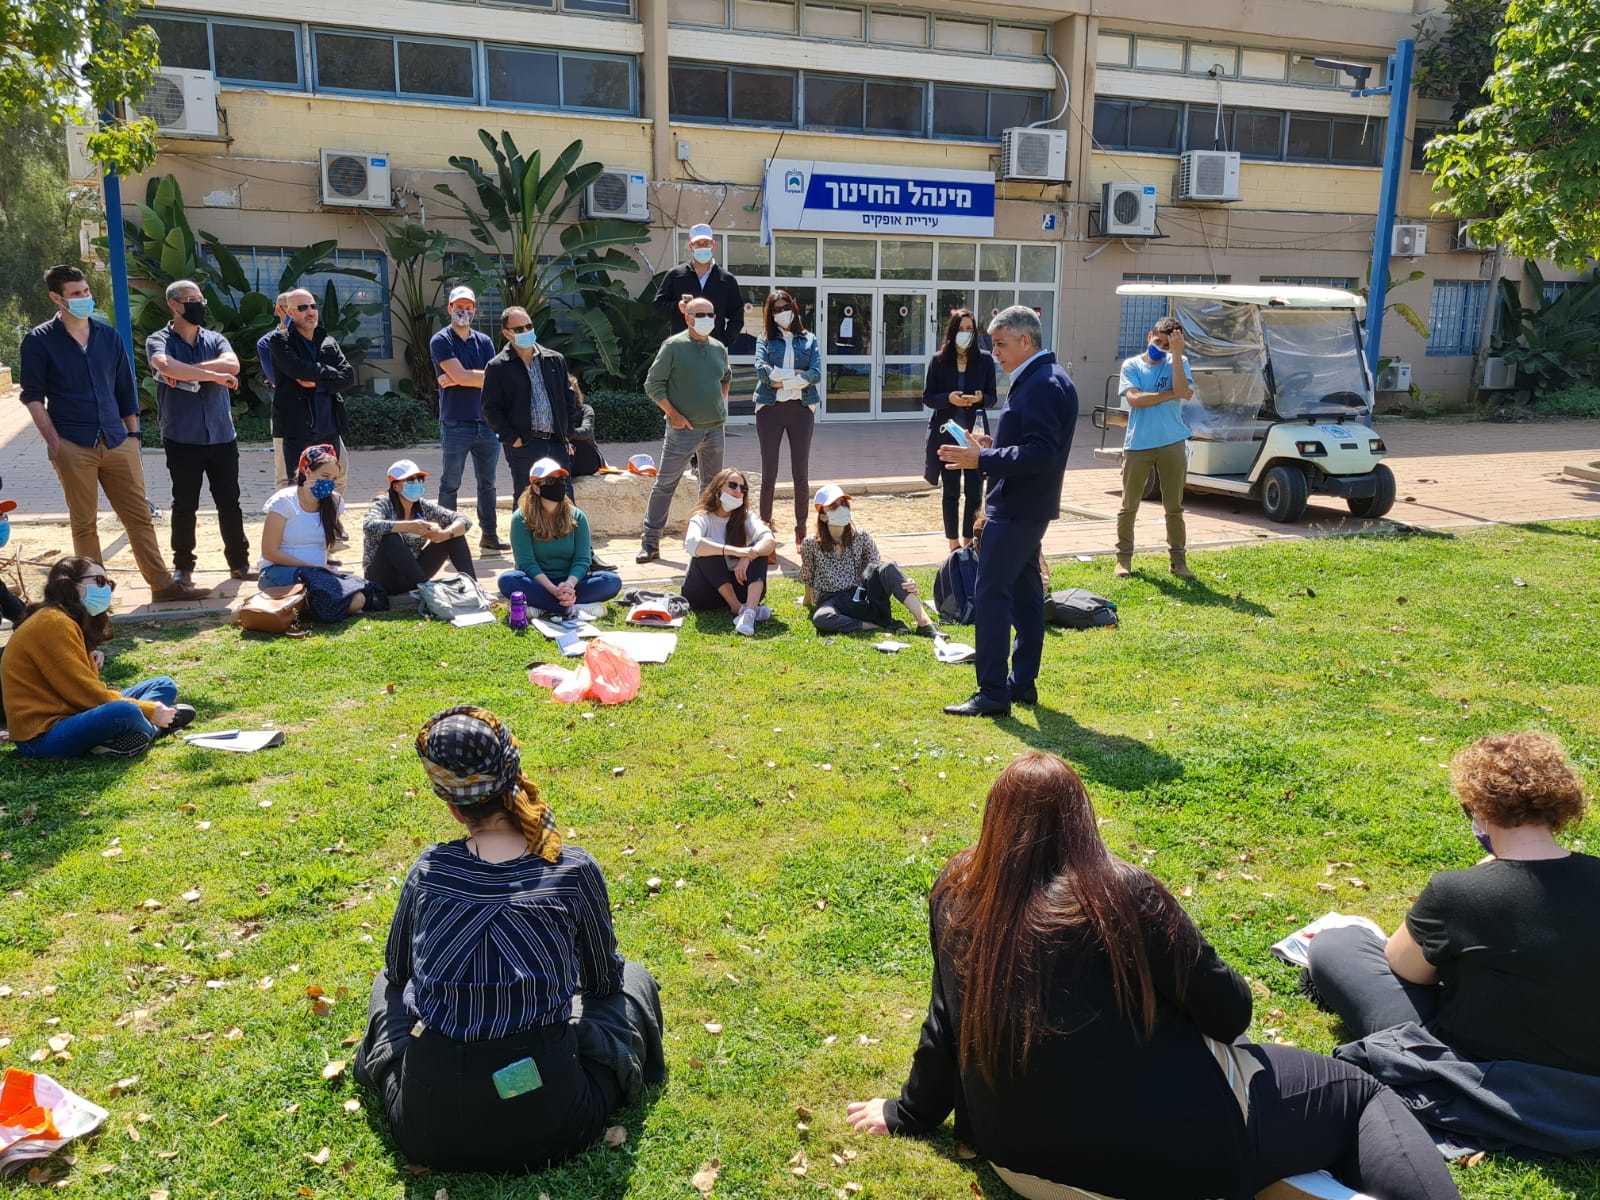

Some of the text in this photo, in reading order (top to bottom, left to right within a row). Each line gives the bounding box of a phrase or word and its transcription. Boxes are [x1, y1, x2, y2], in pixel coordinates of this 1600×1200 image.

[825, 181, 972, 208] מינהל החינוך
[862, 214, 939, 228] עיריית אופקים
